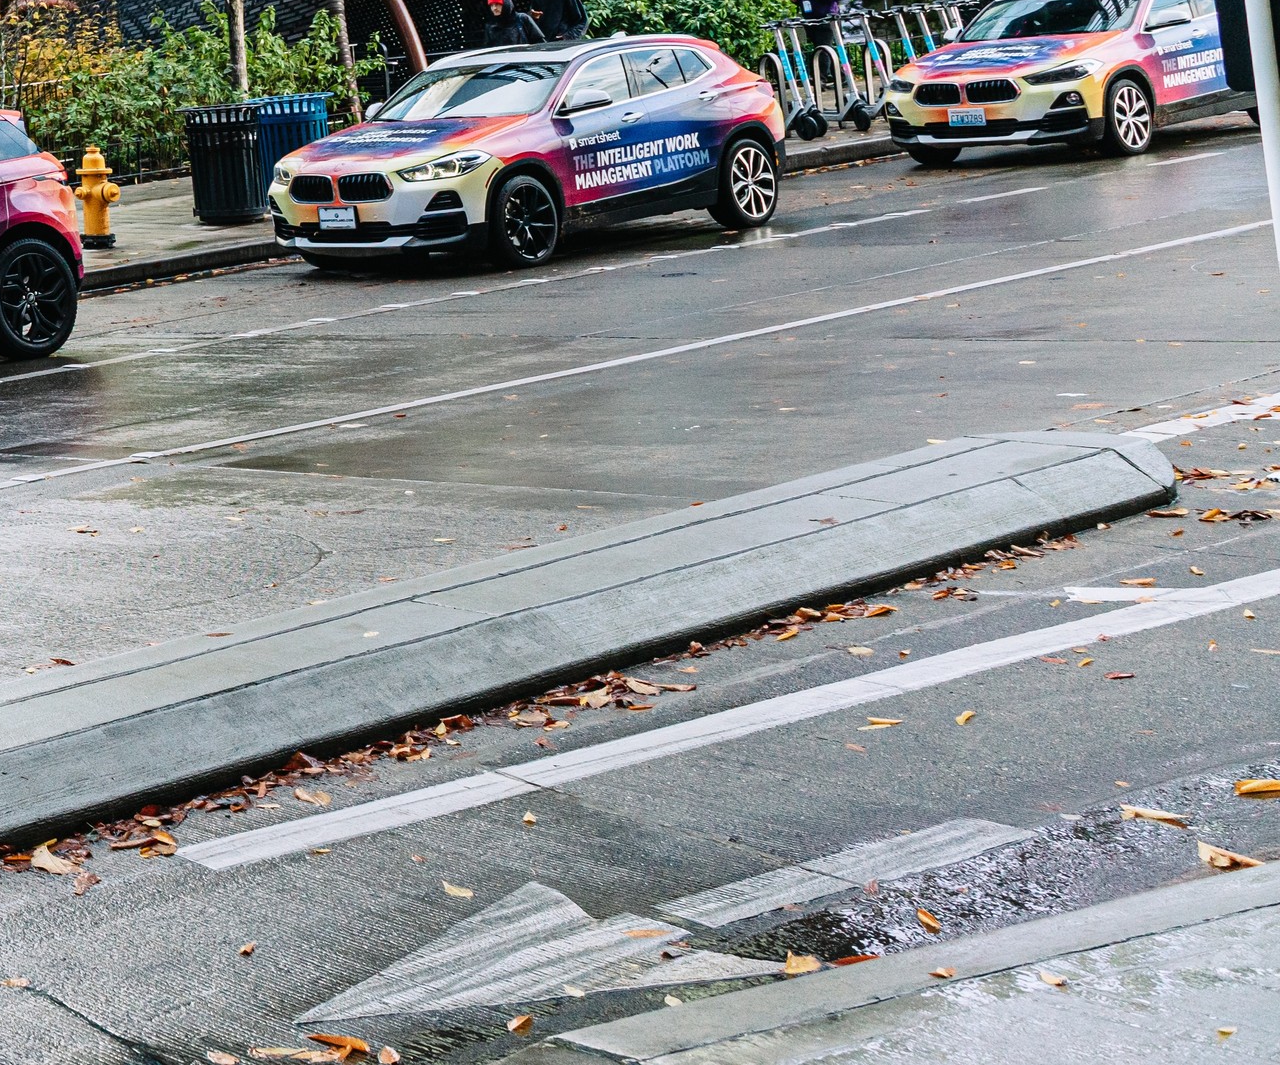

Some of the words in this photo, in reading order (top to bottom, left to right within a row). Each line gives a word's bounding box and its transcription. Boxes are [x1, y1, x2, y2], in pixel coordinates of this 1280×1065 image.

[1161, 58, 1177, 72] THE
[1177, 48, 1223, 69] INTELLIGENT
[1163, 65, 1217, 88] MANAGEMENT
[578, 130, 621, 148] smartsheet
[573, 153, 595, 172] THE
[596, 138, 665, 168] INTELLIGENT
[665, 132, 700, 153] WORK
[575, 160, 653, 190] MANAGEMENT
[654, 149, 710, 175] PLATFORM
